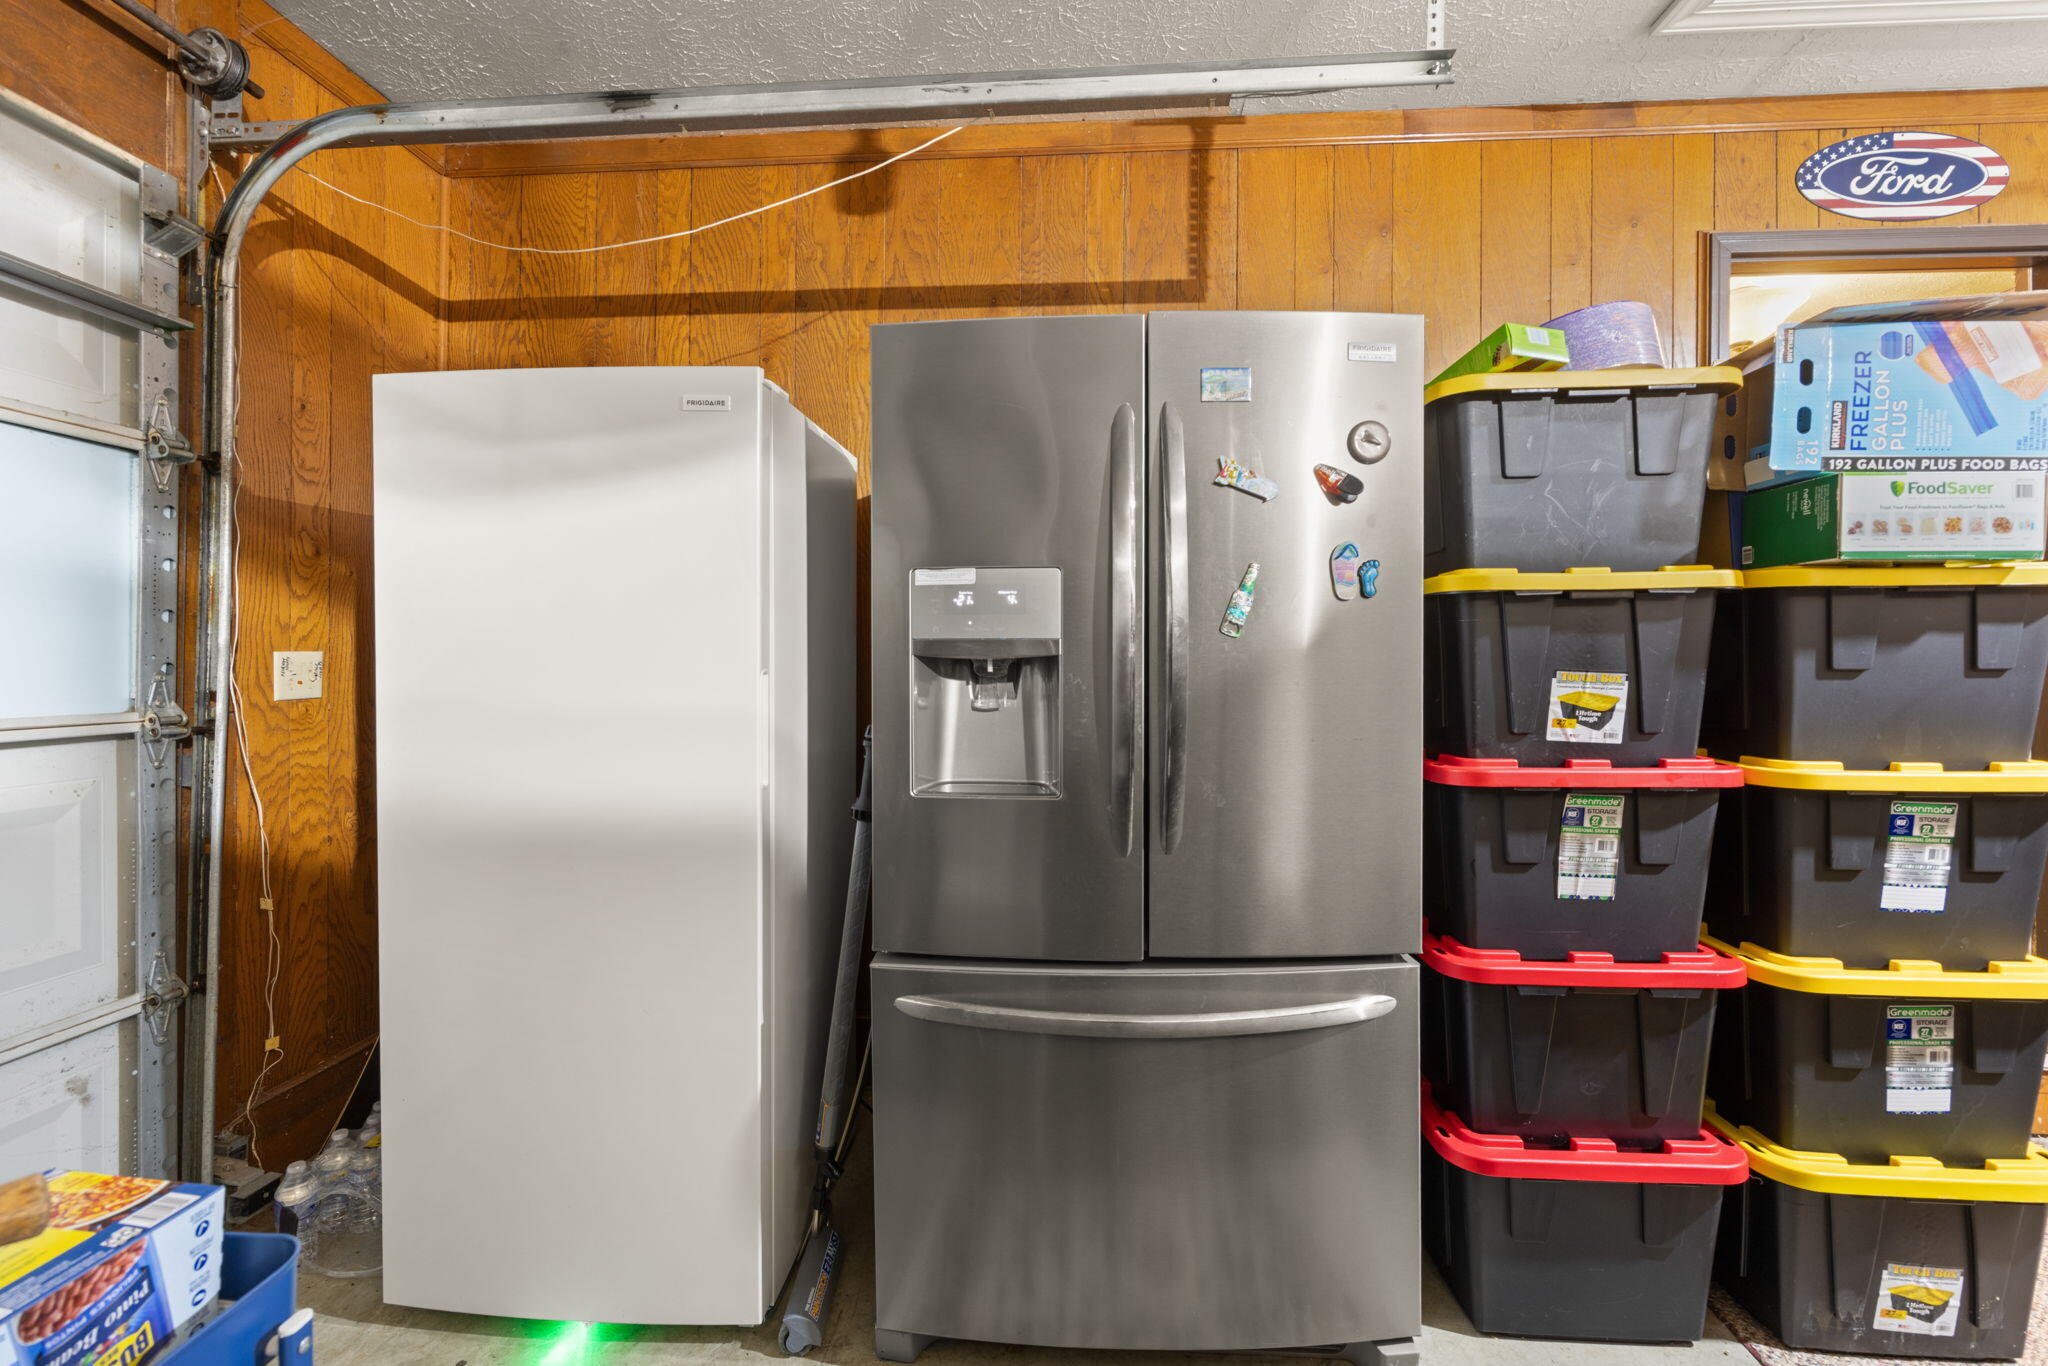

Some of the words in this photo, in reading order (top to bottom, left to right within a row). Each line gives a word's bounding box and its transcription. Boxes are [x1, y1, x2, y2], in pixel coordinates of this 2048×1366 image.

[1850, 156, 1956, 196] Ford
[1850, 351, 1873, 452] FREEZER
[1872, 370, 1891, 452] GALLON
[1831, 402, 1842, 449] KIRKLAND
[1890, 400, 1908, 450] PLUS
[1805, 440, 1818, 465] 192
[1829, 458, 1852, 470] 192
[1856, 458, 1917, 470] GALLON
[1921, 458, 1957, 470] PLUS
[1961, 458, 2005, 470] FOOD
[2010, 458, 2048, 470] BAGS
[1908, 481, 1994, 495] FoodSaver
[1802, 488, 1811, 516] newell
[1561, 672, 1597, 683] Tough
[1600, 673, 1623, 684] Box
[1567, 797, 1619, 806] Greenmade
[1894, 804, 1953, 813] Greenmade
[1591, 816, 1600, 824] 27
[1890, 1008, 1949, 1016] Greenmade
[1892, 1265, 1931, 1277] Tough
[1934, 1268, 1957, 1279] Box
[104, 1280, 150, 1328] Pinto
[1909, 1307, 1930, 1316] Tough
[45, 1315, 87, 1350] PINTOS
